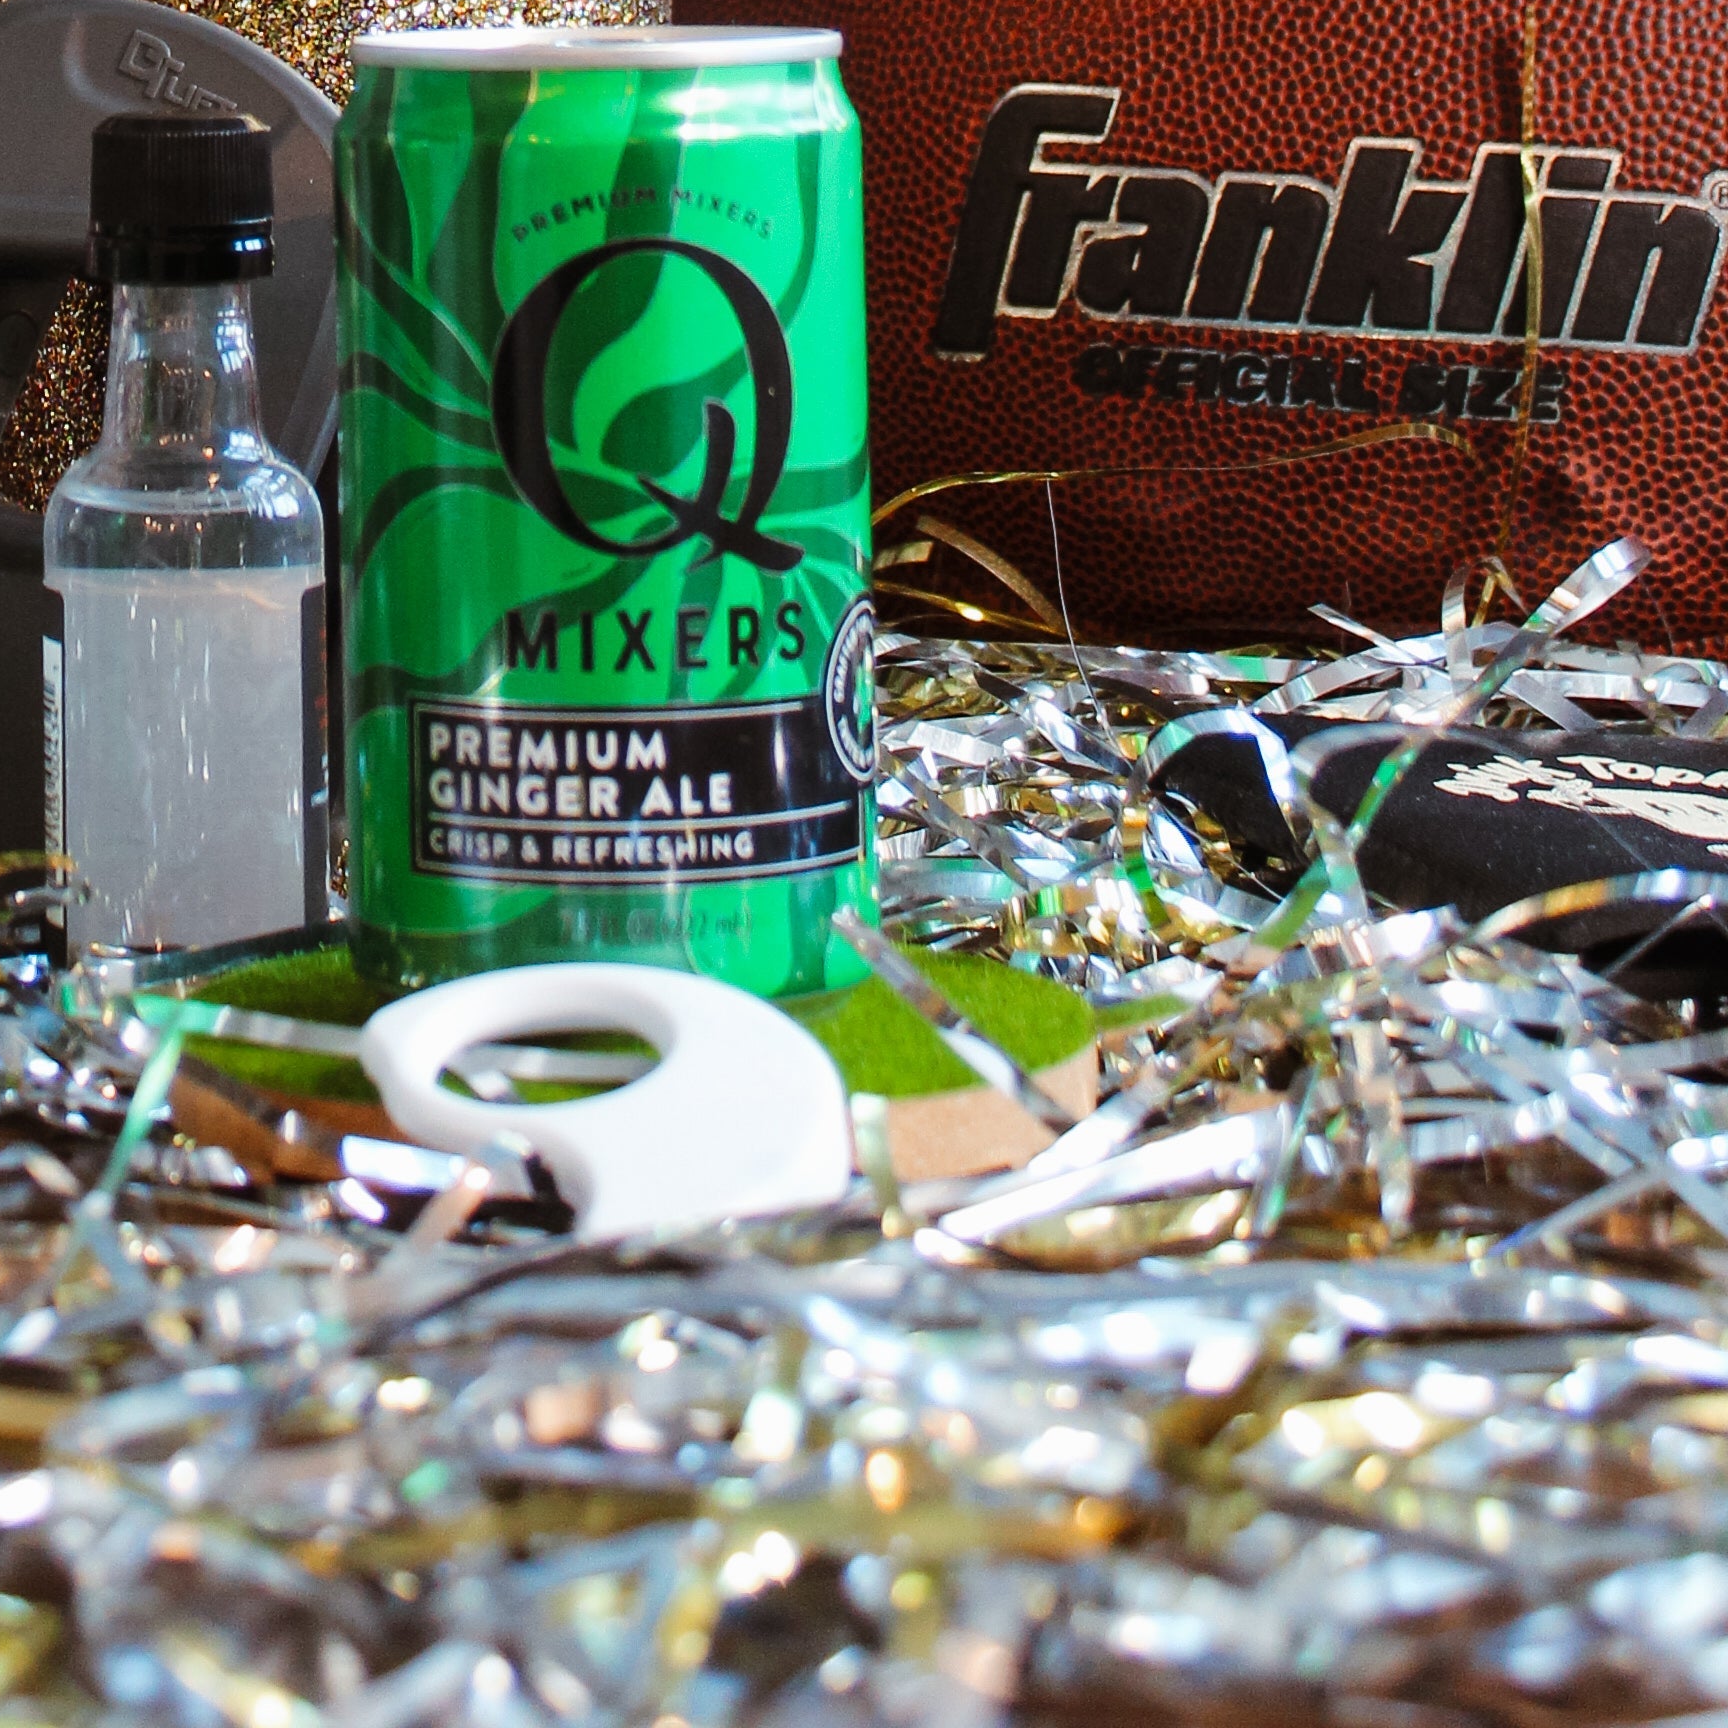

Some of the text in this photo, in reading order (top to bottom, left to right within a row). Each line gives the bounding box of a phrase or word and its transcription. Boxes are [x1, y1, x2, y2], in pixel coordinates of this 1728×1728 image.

[672, 186, 774, 240] MIXERS
[491, 237, 806, 578] Q
[1073, 342, 1566, 424] OFFICIAL SIZE
[506, 601, 807, 672] MIXERS
[428, 721, 669, 773] PREMIUM
[429, 768, 735, 819] GINGER ALE
[428, 828, 756, 866] CRISP & REFRESHING
